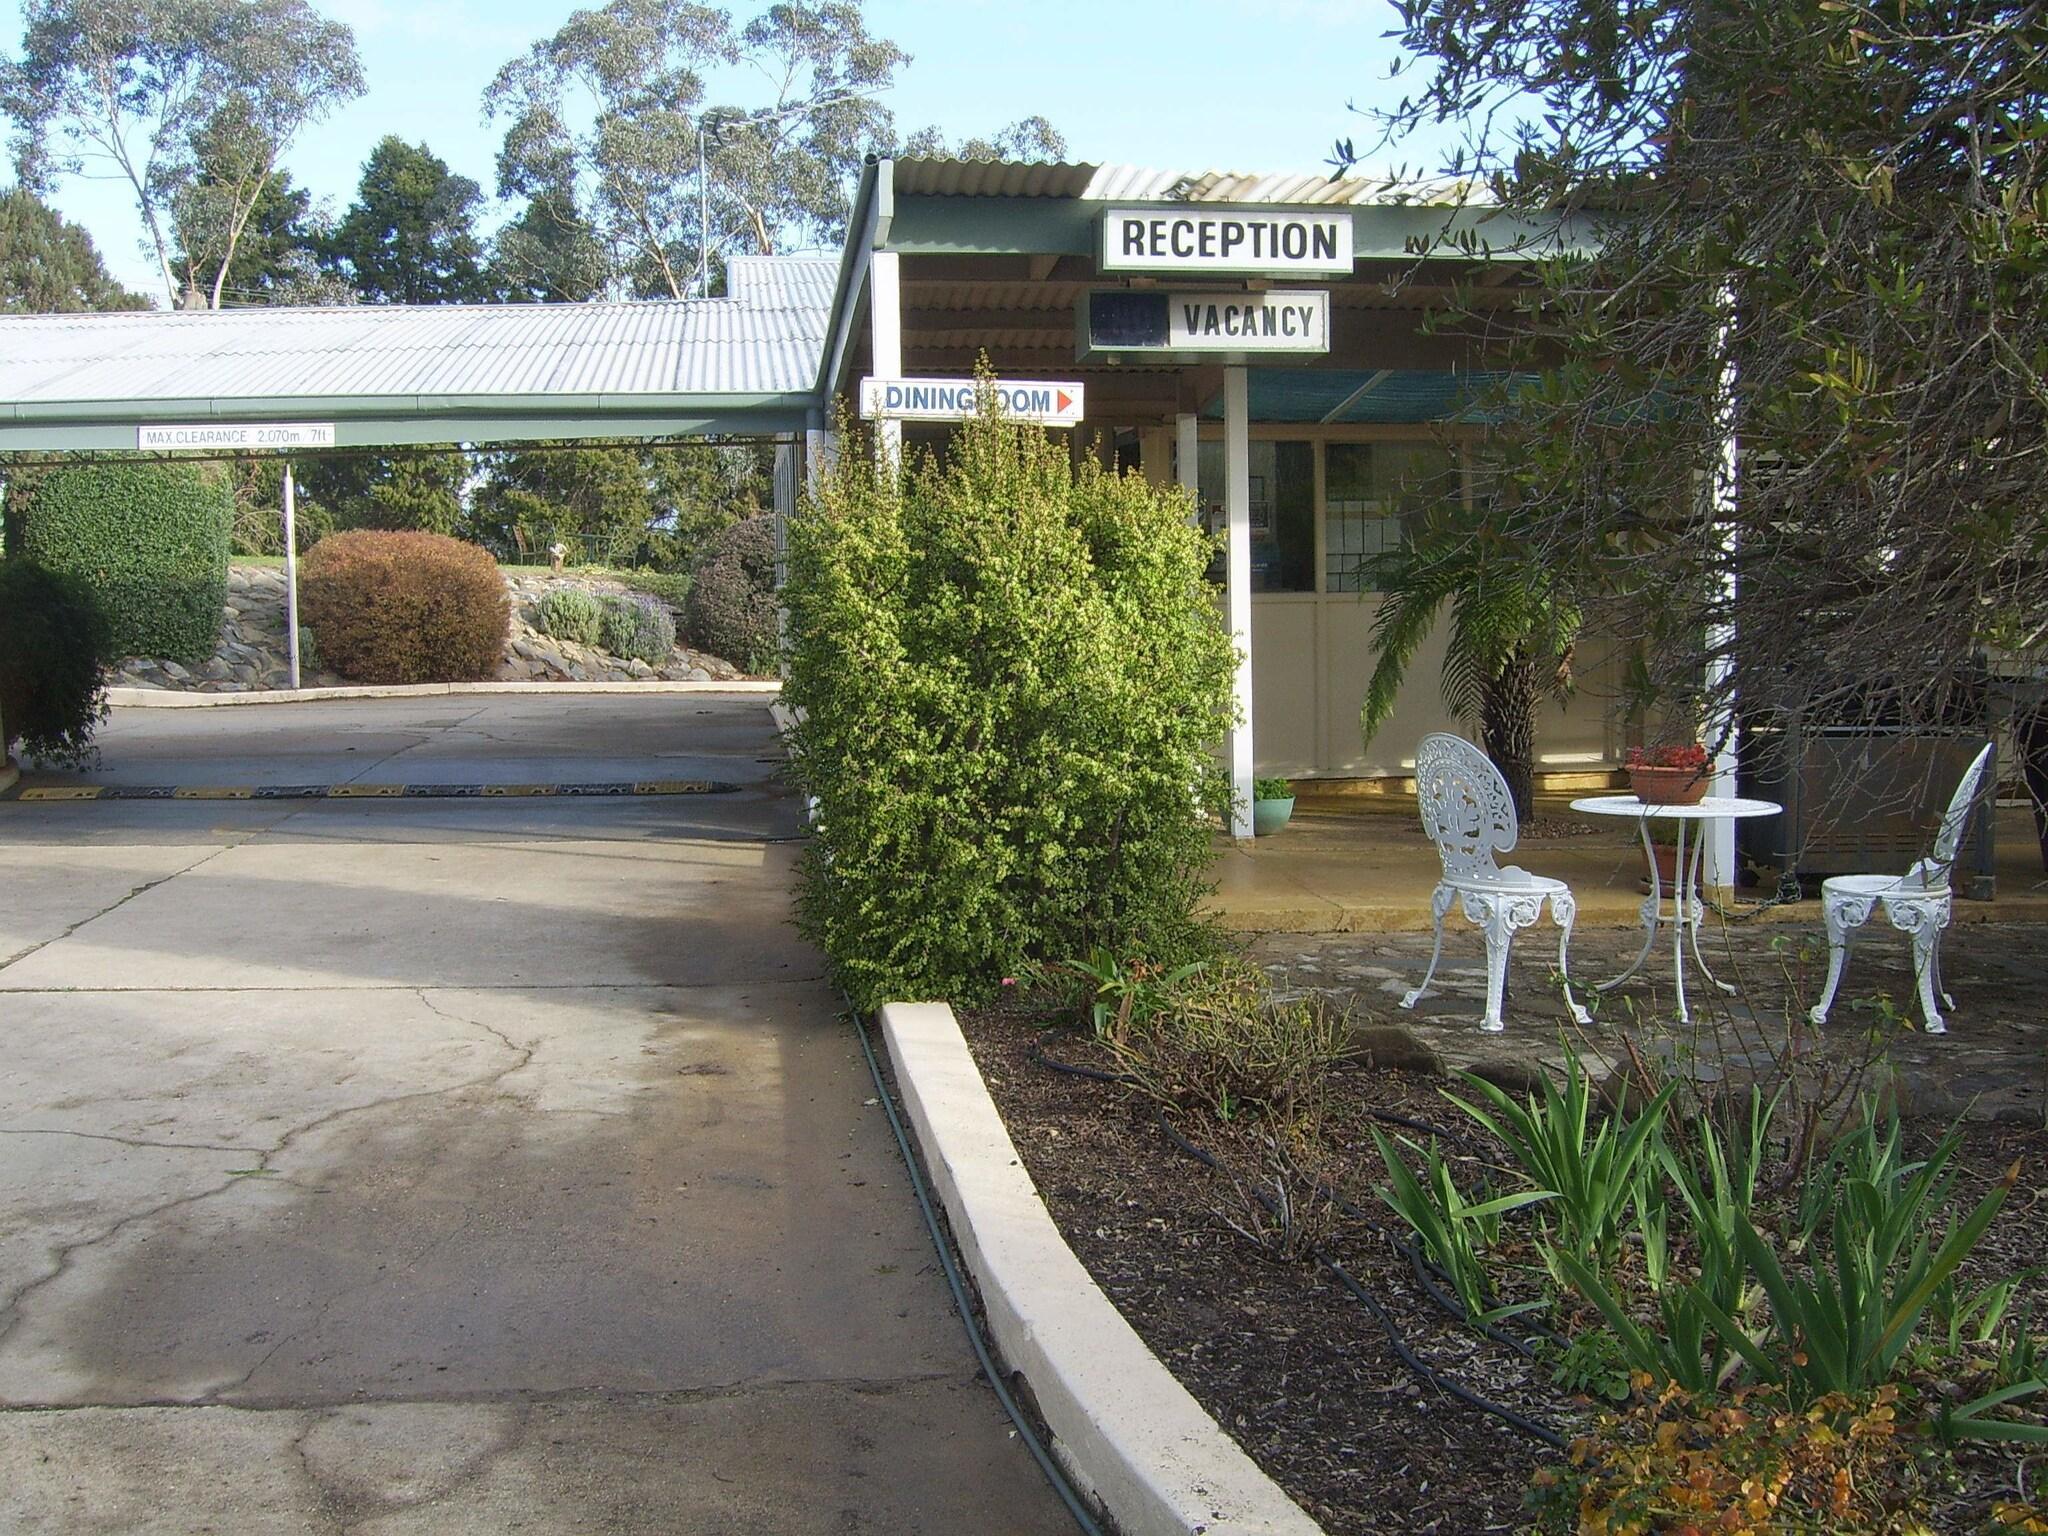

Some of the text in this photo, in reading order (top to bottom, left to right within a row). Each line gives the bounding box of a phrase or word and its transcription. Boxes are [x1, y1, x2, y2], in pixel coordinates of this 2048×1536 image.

[1122, 219, 1337, 260] RECEPTION
[1183, 303, 1314, 337] VACANCY
[886, 386, 1050, 413] DINING OOM
